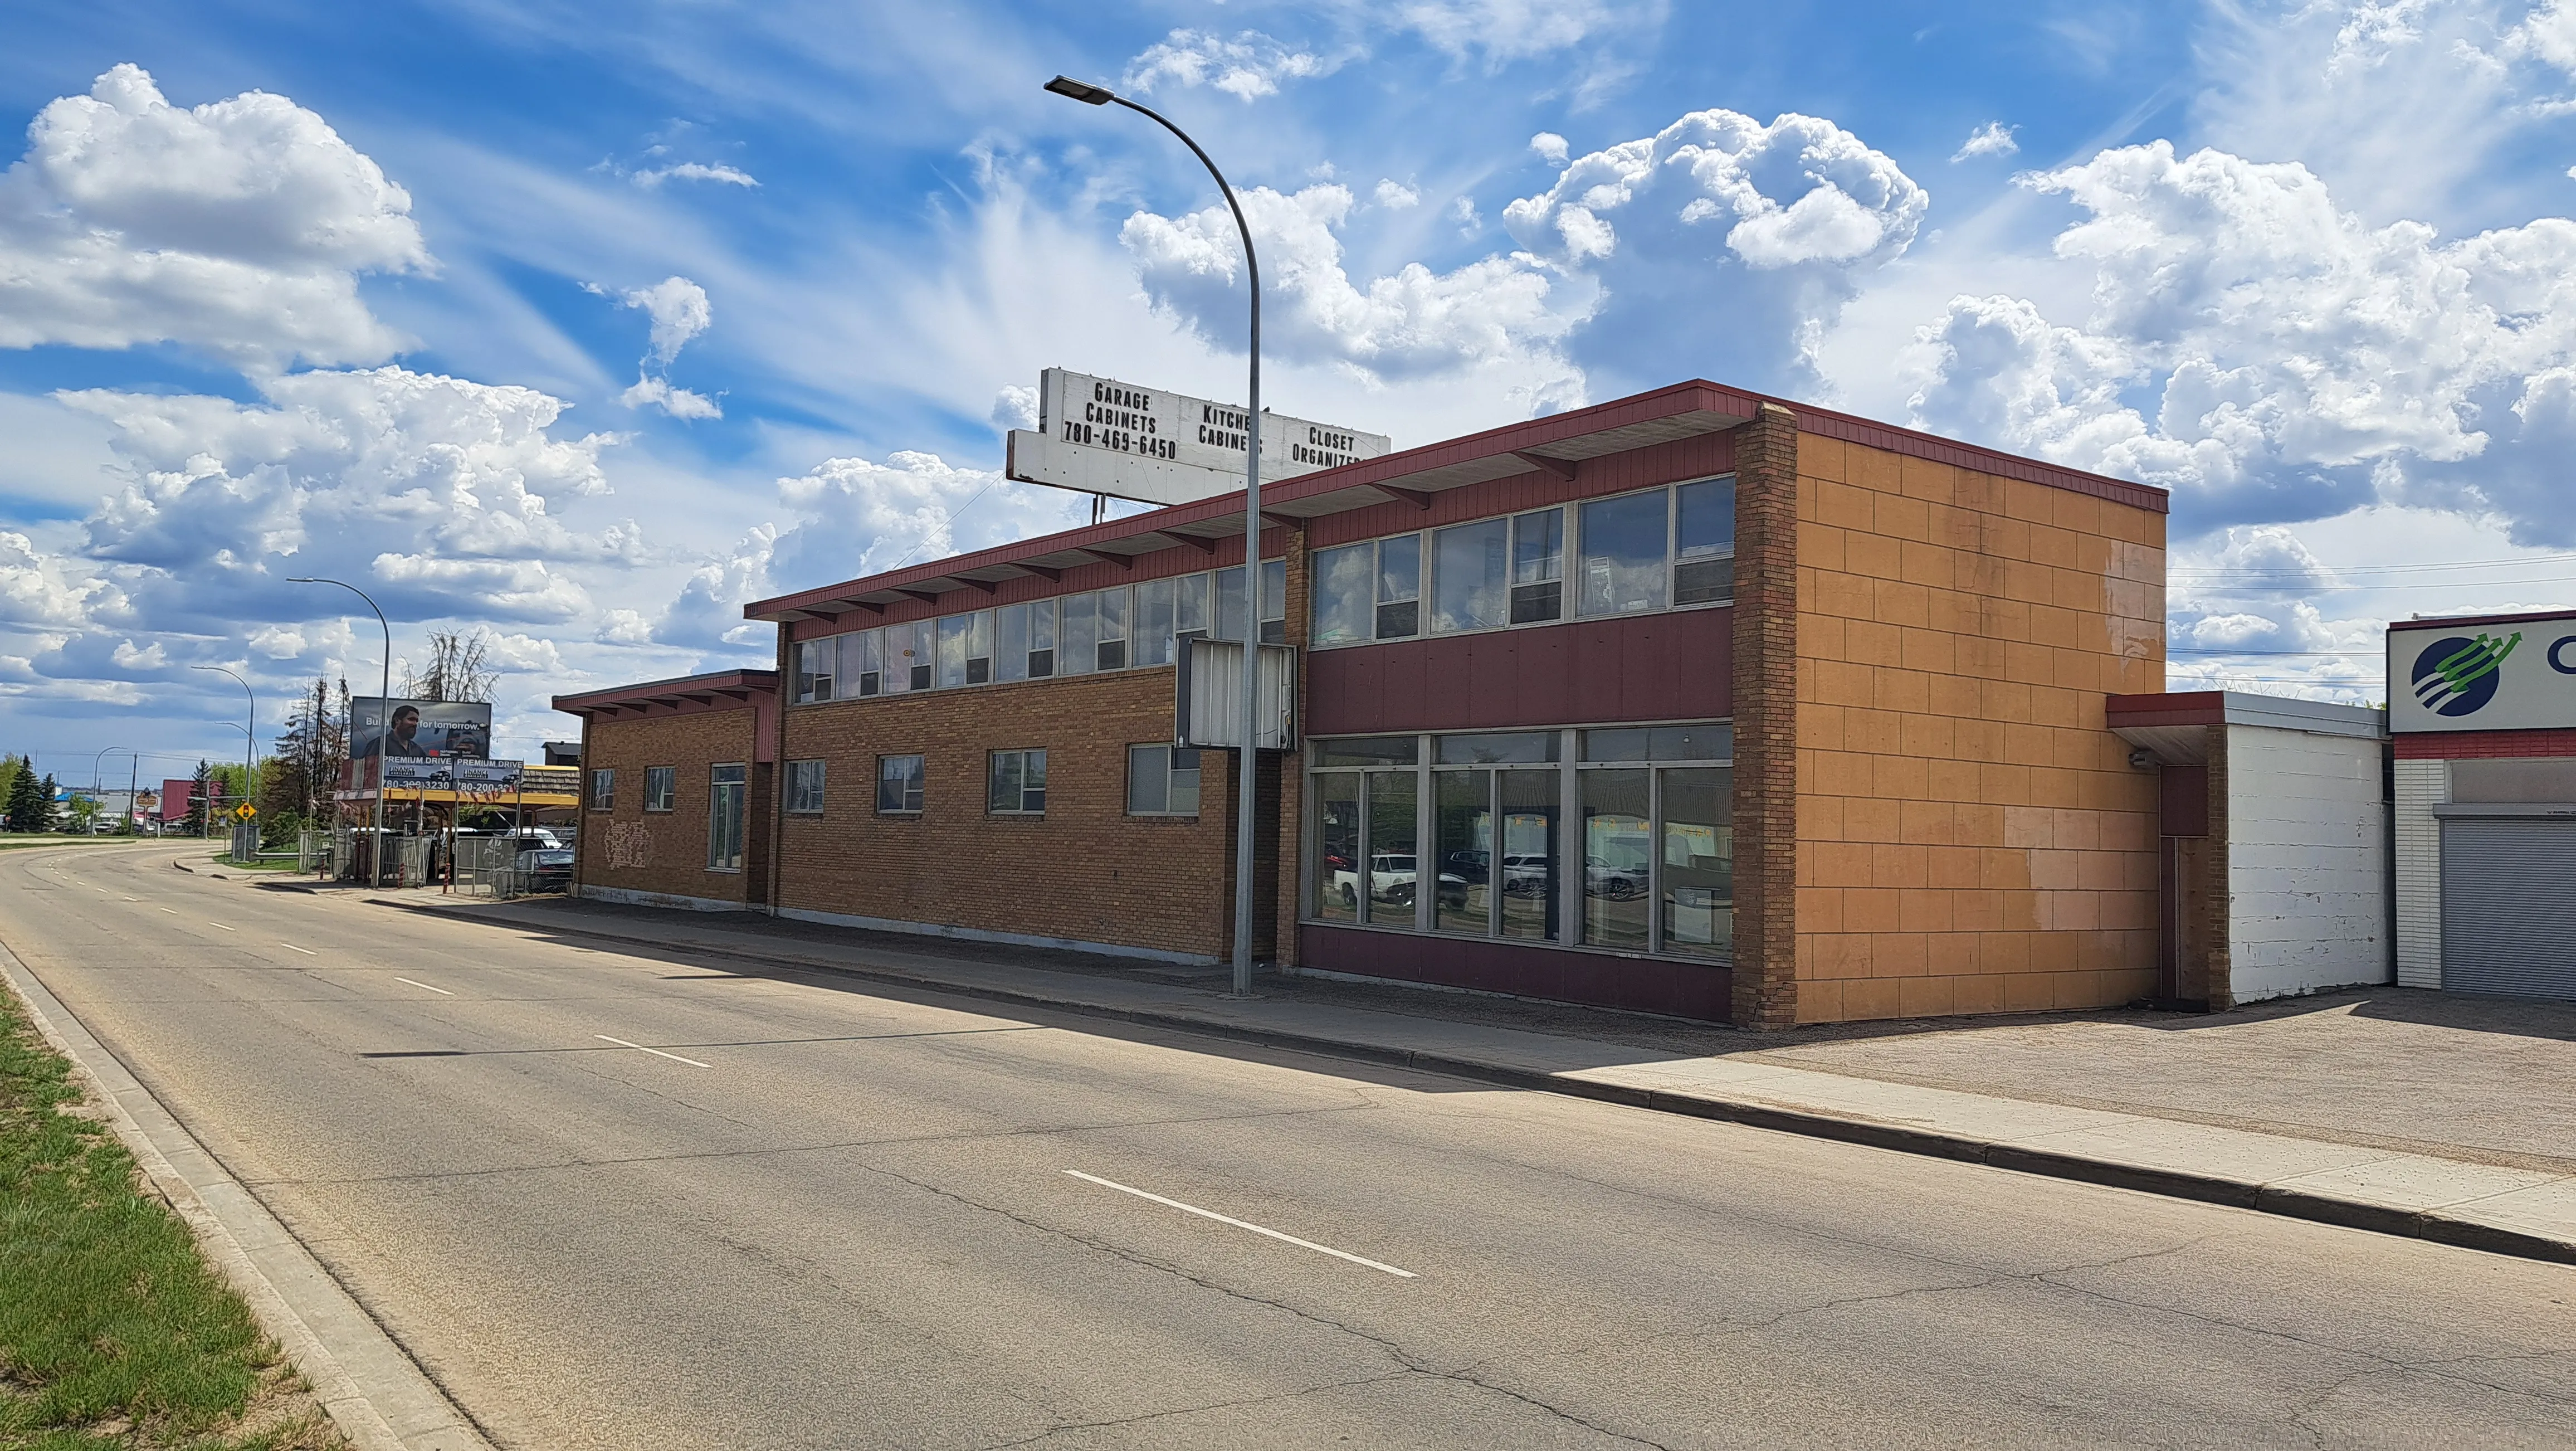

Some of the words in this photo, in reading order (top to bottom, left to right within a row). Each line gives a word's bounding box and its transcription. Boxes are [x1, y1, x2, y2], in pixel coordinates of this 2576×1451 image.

[1094, 382, 1149, 411] GARAGE
[1086, 402, 1156, 434] CABINETS
[1203, 404, 1250, 432] KITCHE
[1065, 421, 1176, 460] 780-469-6450
[1199, 424, 1262, 455] CABINE
[1309, 426, 1354, 452] CLOSET
[419, 719, 432, 728] for
[434, 720, 480, 731] tomorrow.
[383, 756, 423, 764] PREMIUM
[457, 758, 496, 767] PREMIUM
